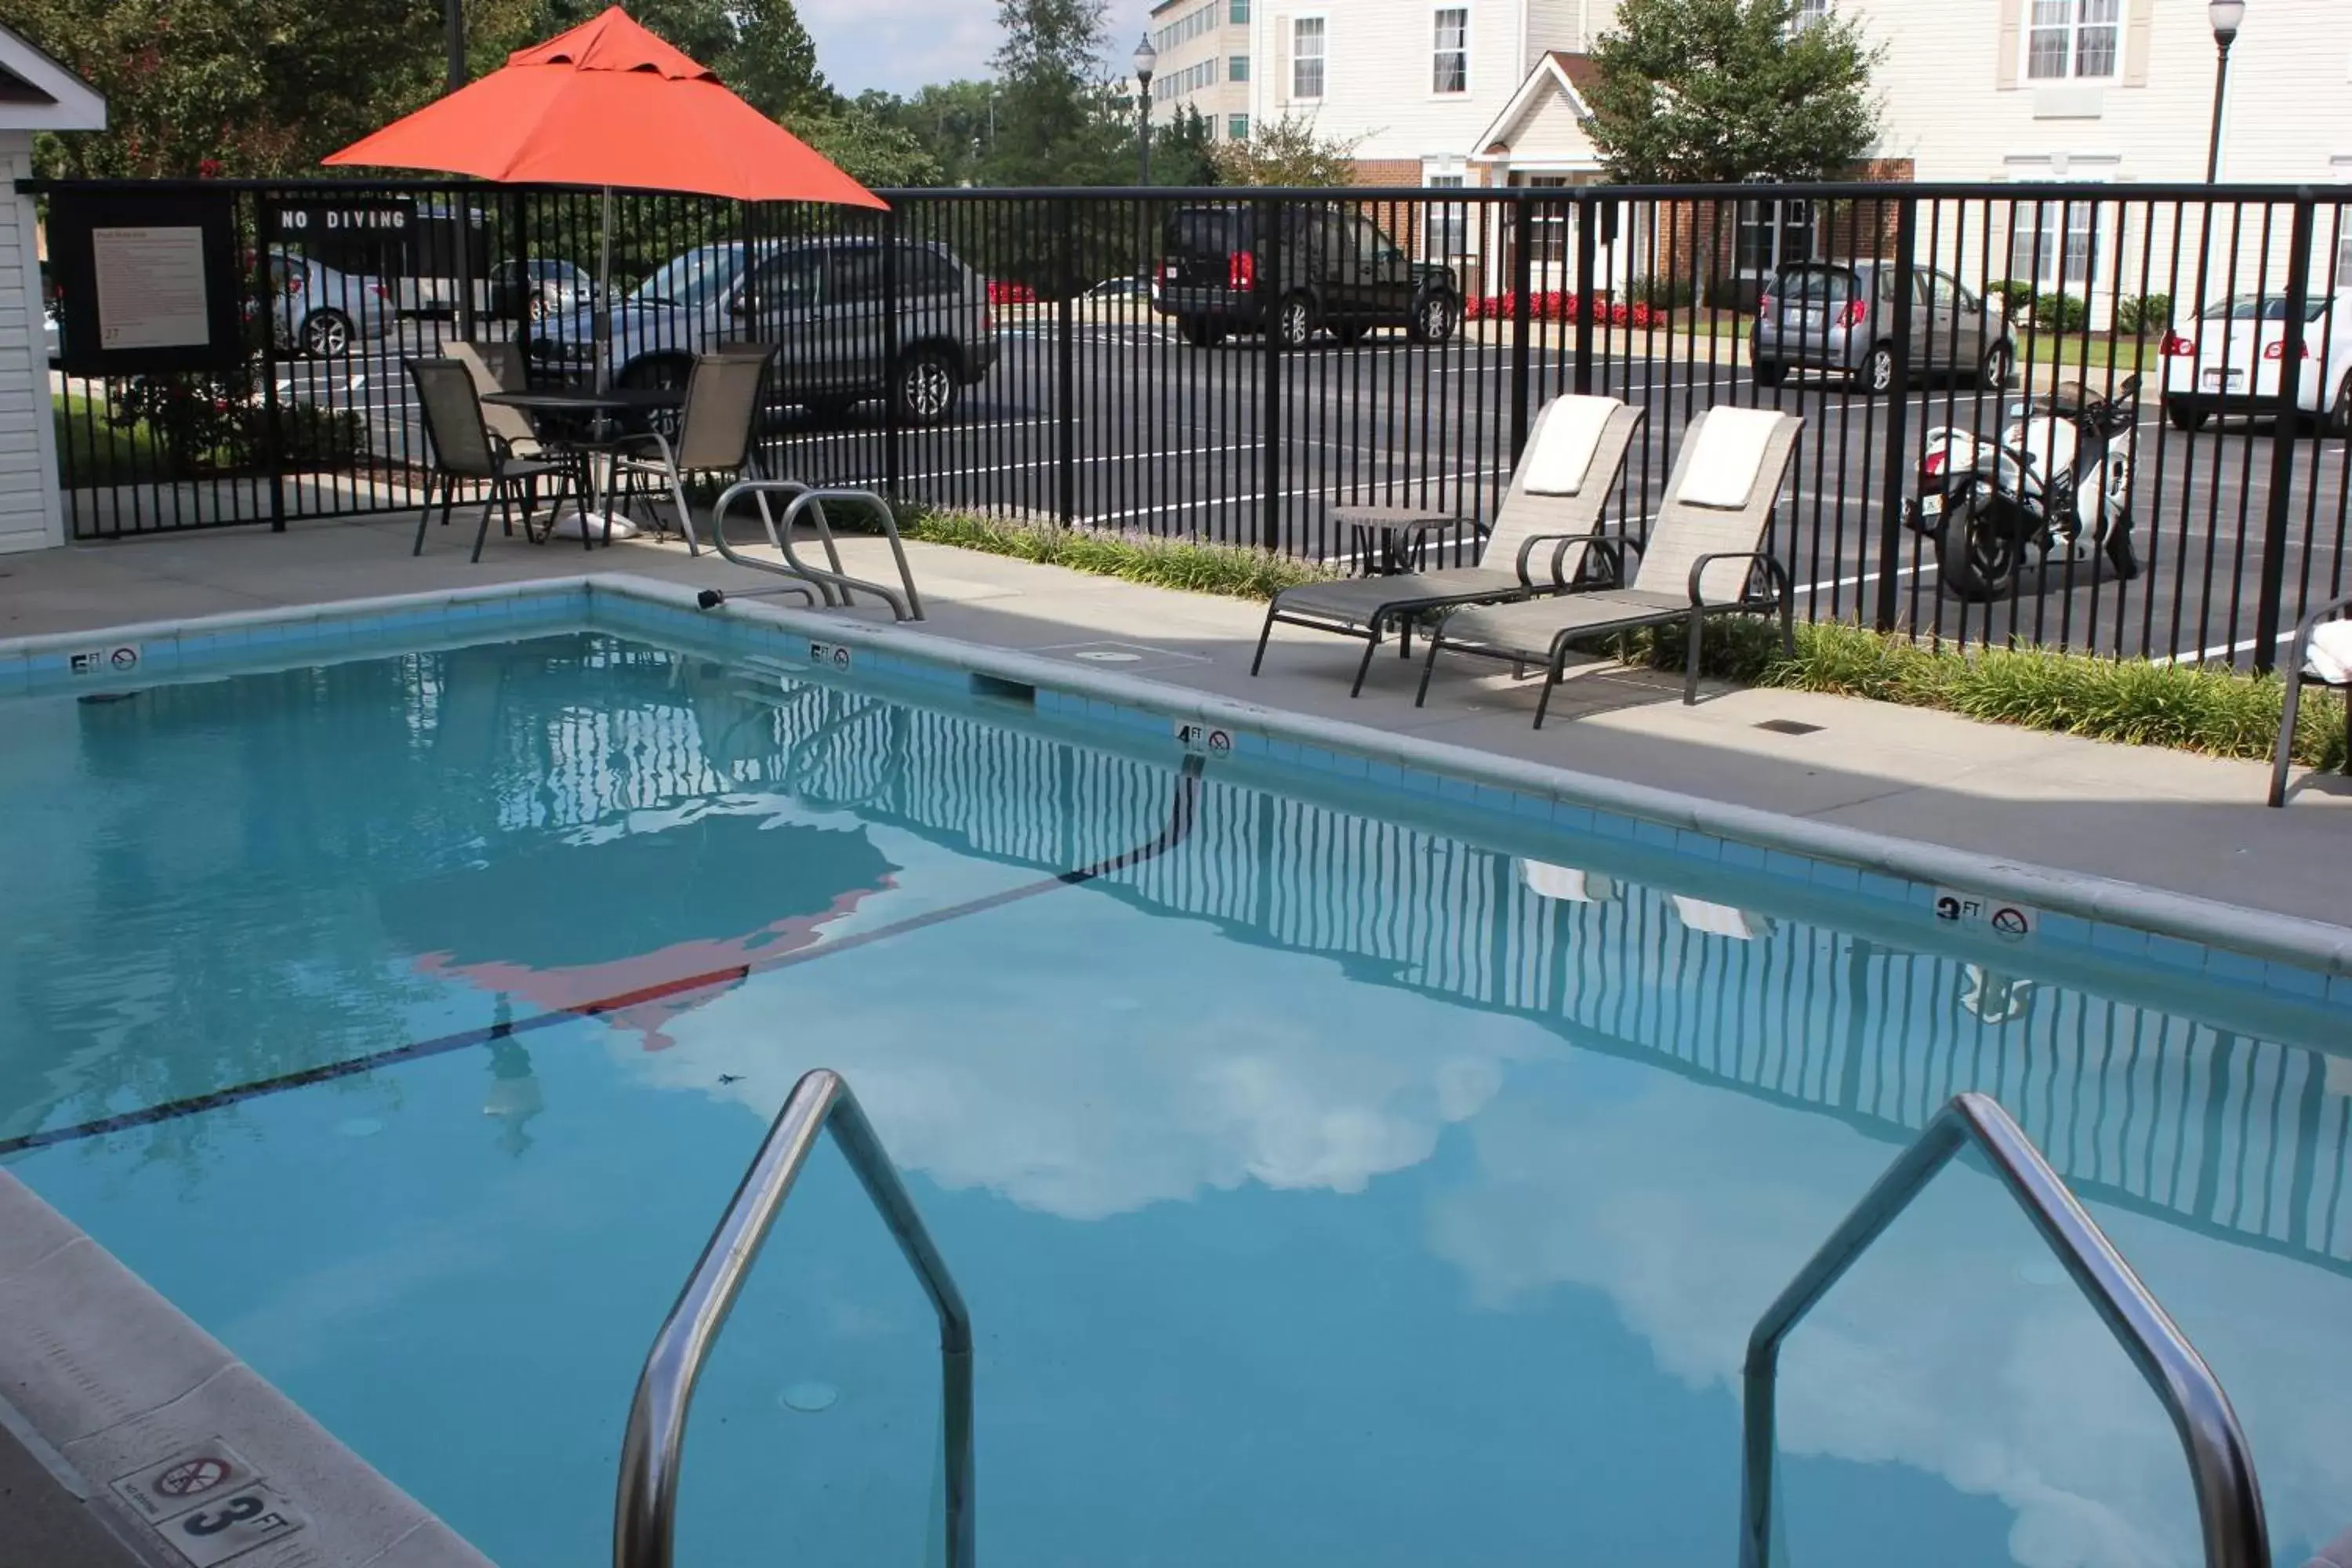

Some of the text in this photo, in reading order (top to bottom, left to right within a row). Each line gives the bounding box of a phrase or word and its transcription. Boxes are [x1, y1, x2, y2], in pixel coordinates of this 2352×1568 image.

[282, 211, 405, 228] NO DIVING
[1177, 725, 1203, 742] 4 FT
[1963, 901, 1981, 916] FT
[183, 1497, 289, 1536] 3 FT
